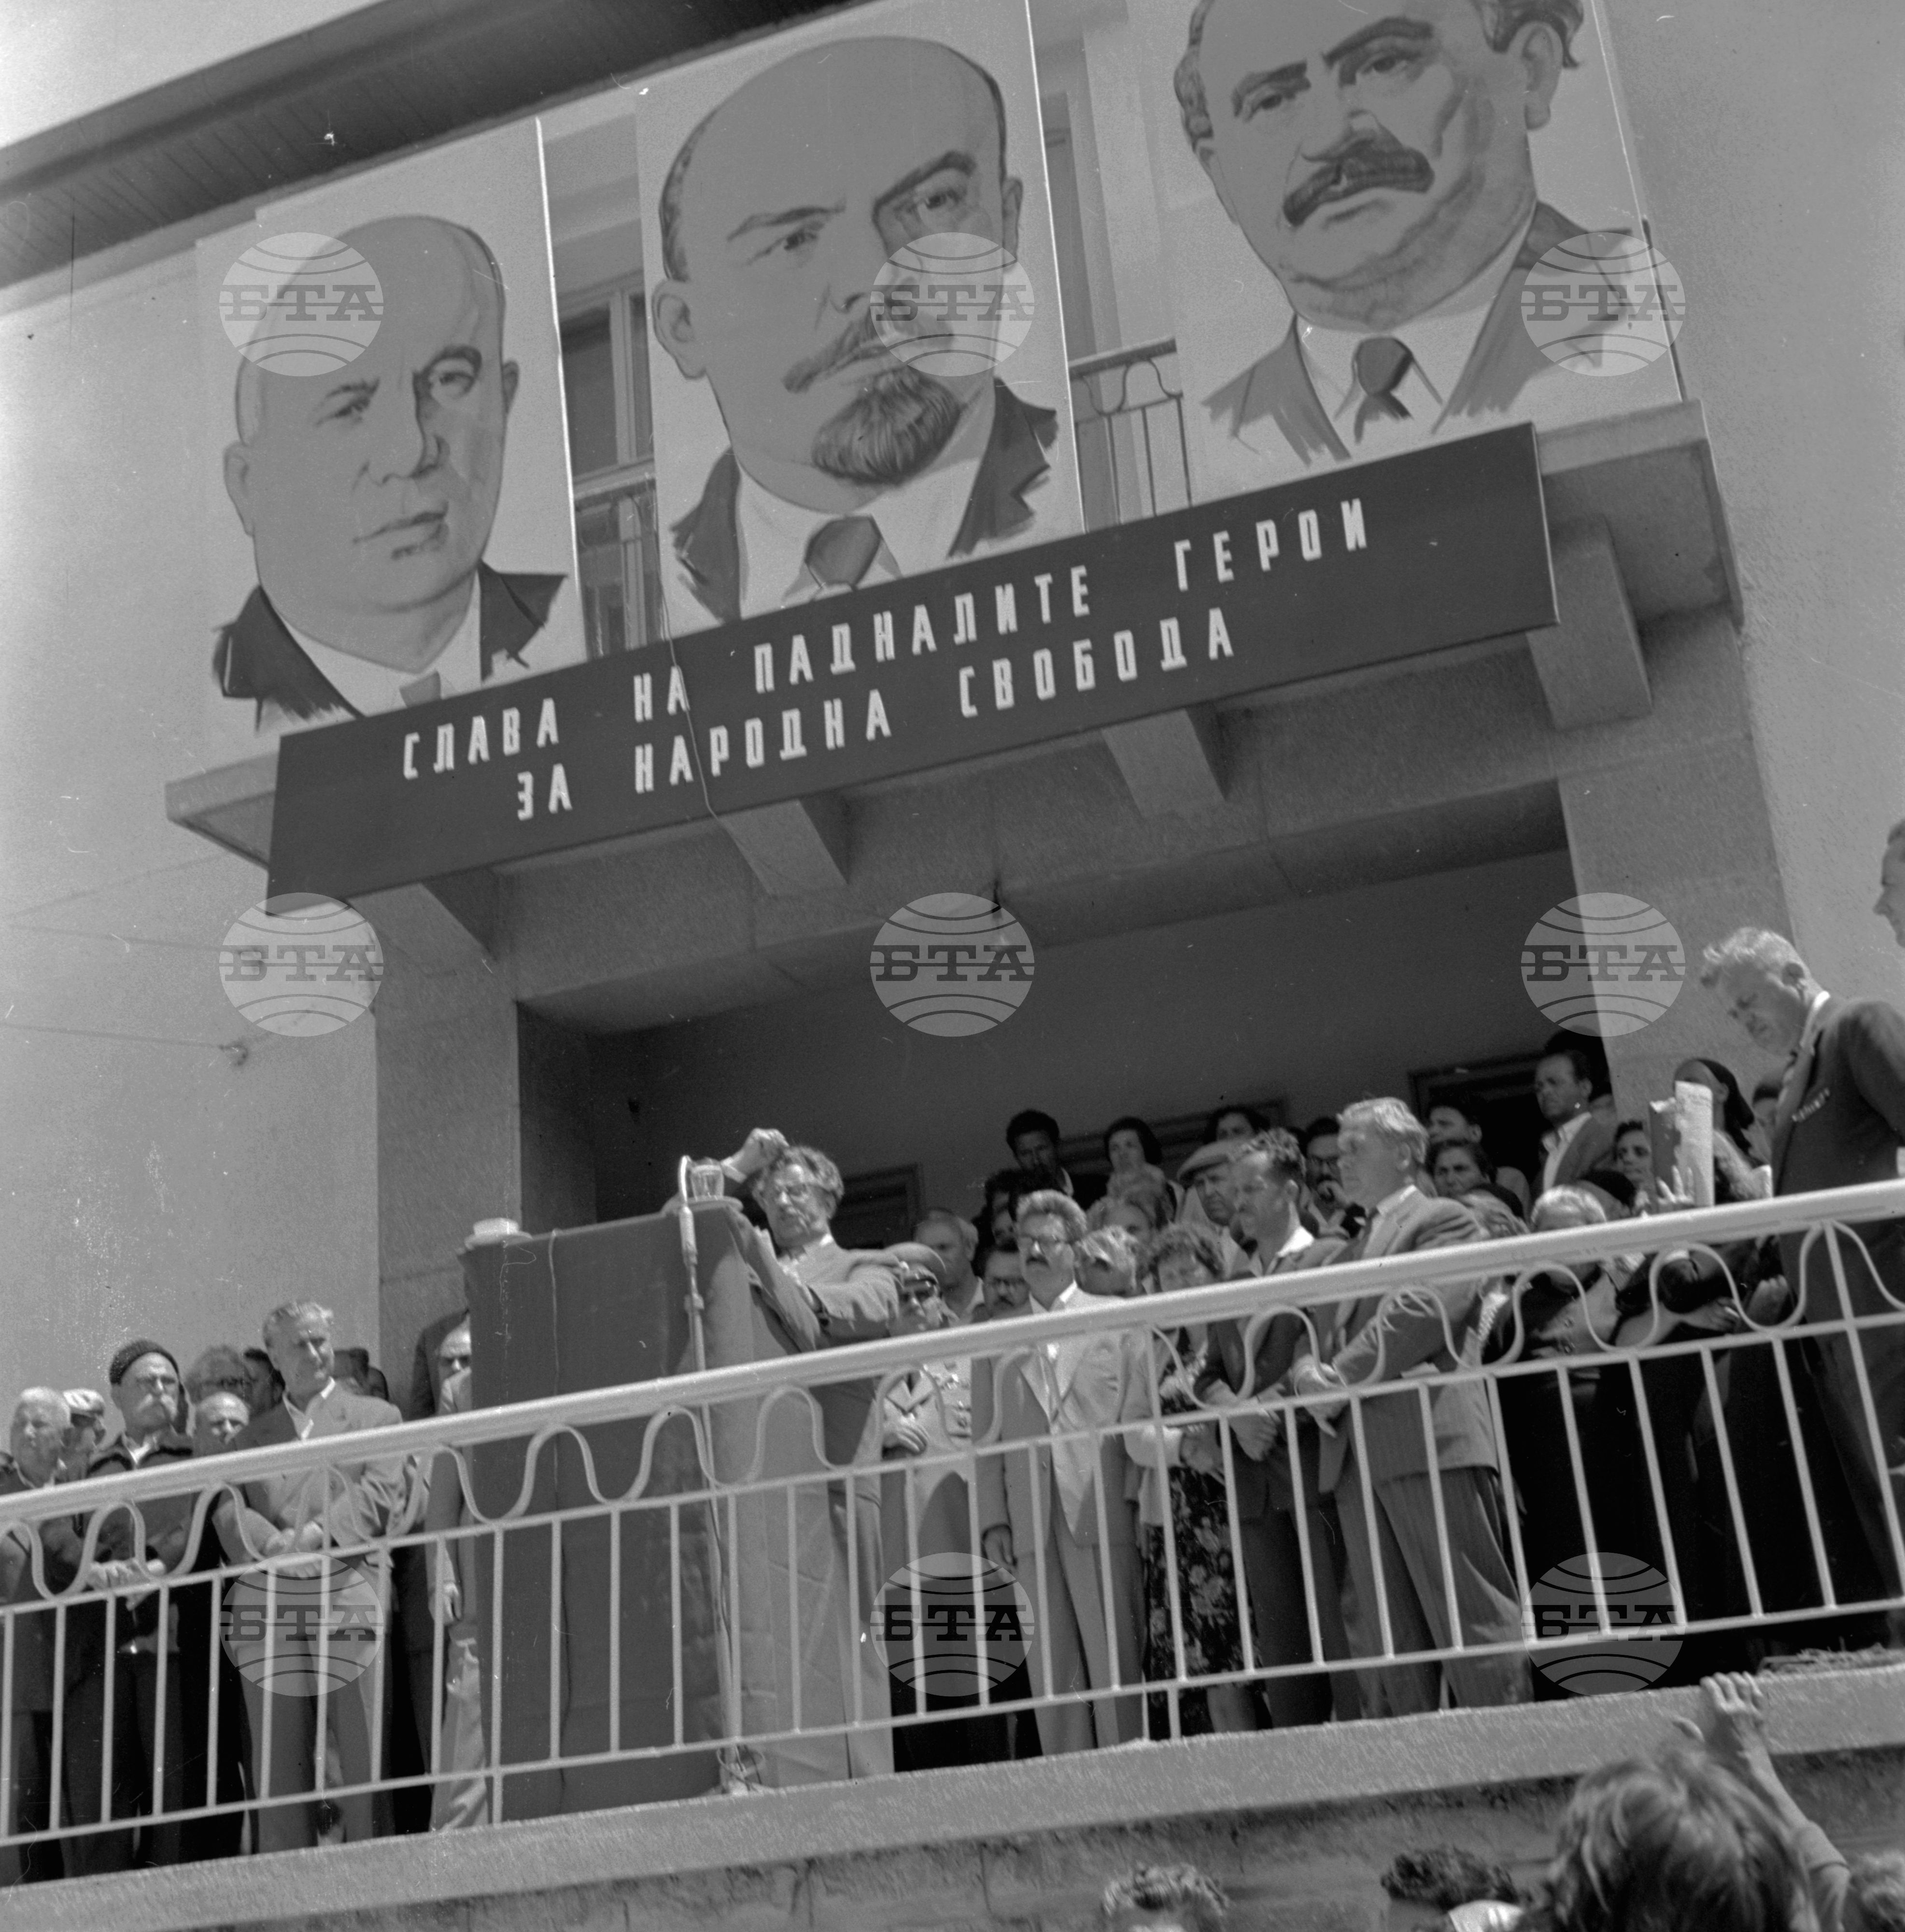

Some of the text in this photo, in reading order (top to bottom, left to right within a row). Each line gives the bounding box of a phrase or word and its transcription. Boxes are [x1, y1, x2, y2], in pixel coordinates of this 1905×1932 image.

[402, 497, 1368, 780] СЛАВА НА ПАДНАЛИТЕ ГЕРОИ
[516, 607, 1234, 821] ЗА НАРОДНА СВОБОДА
